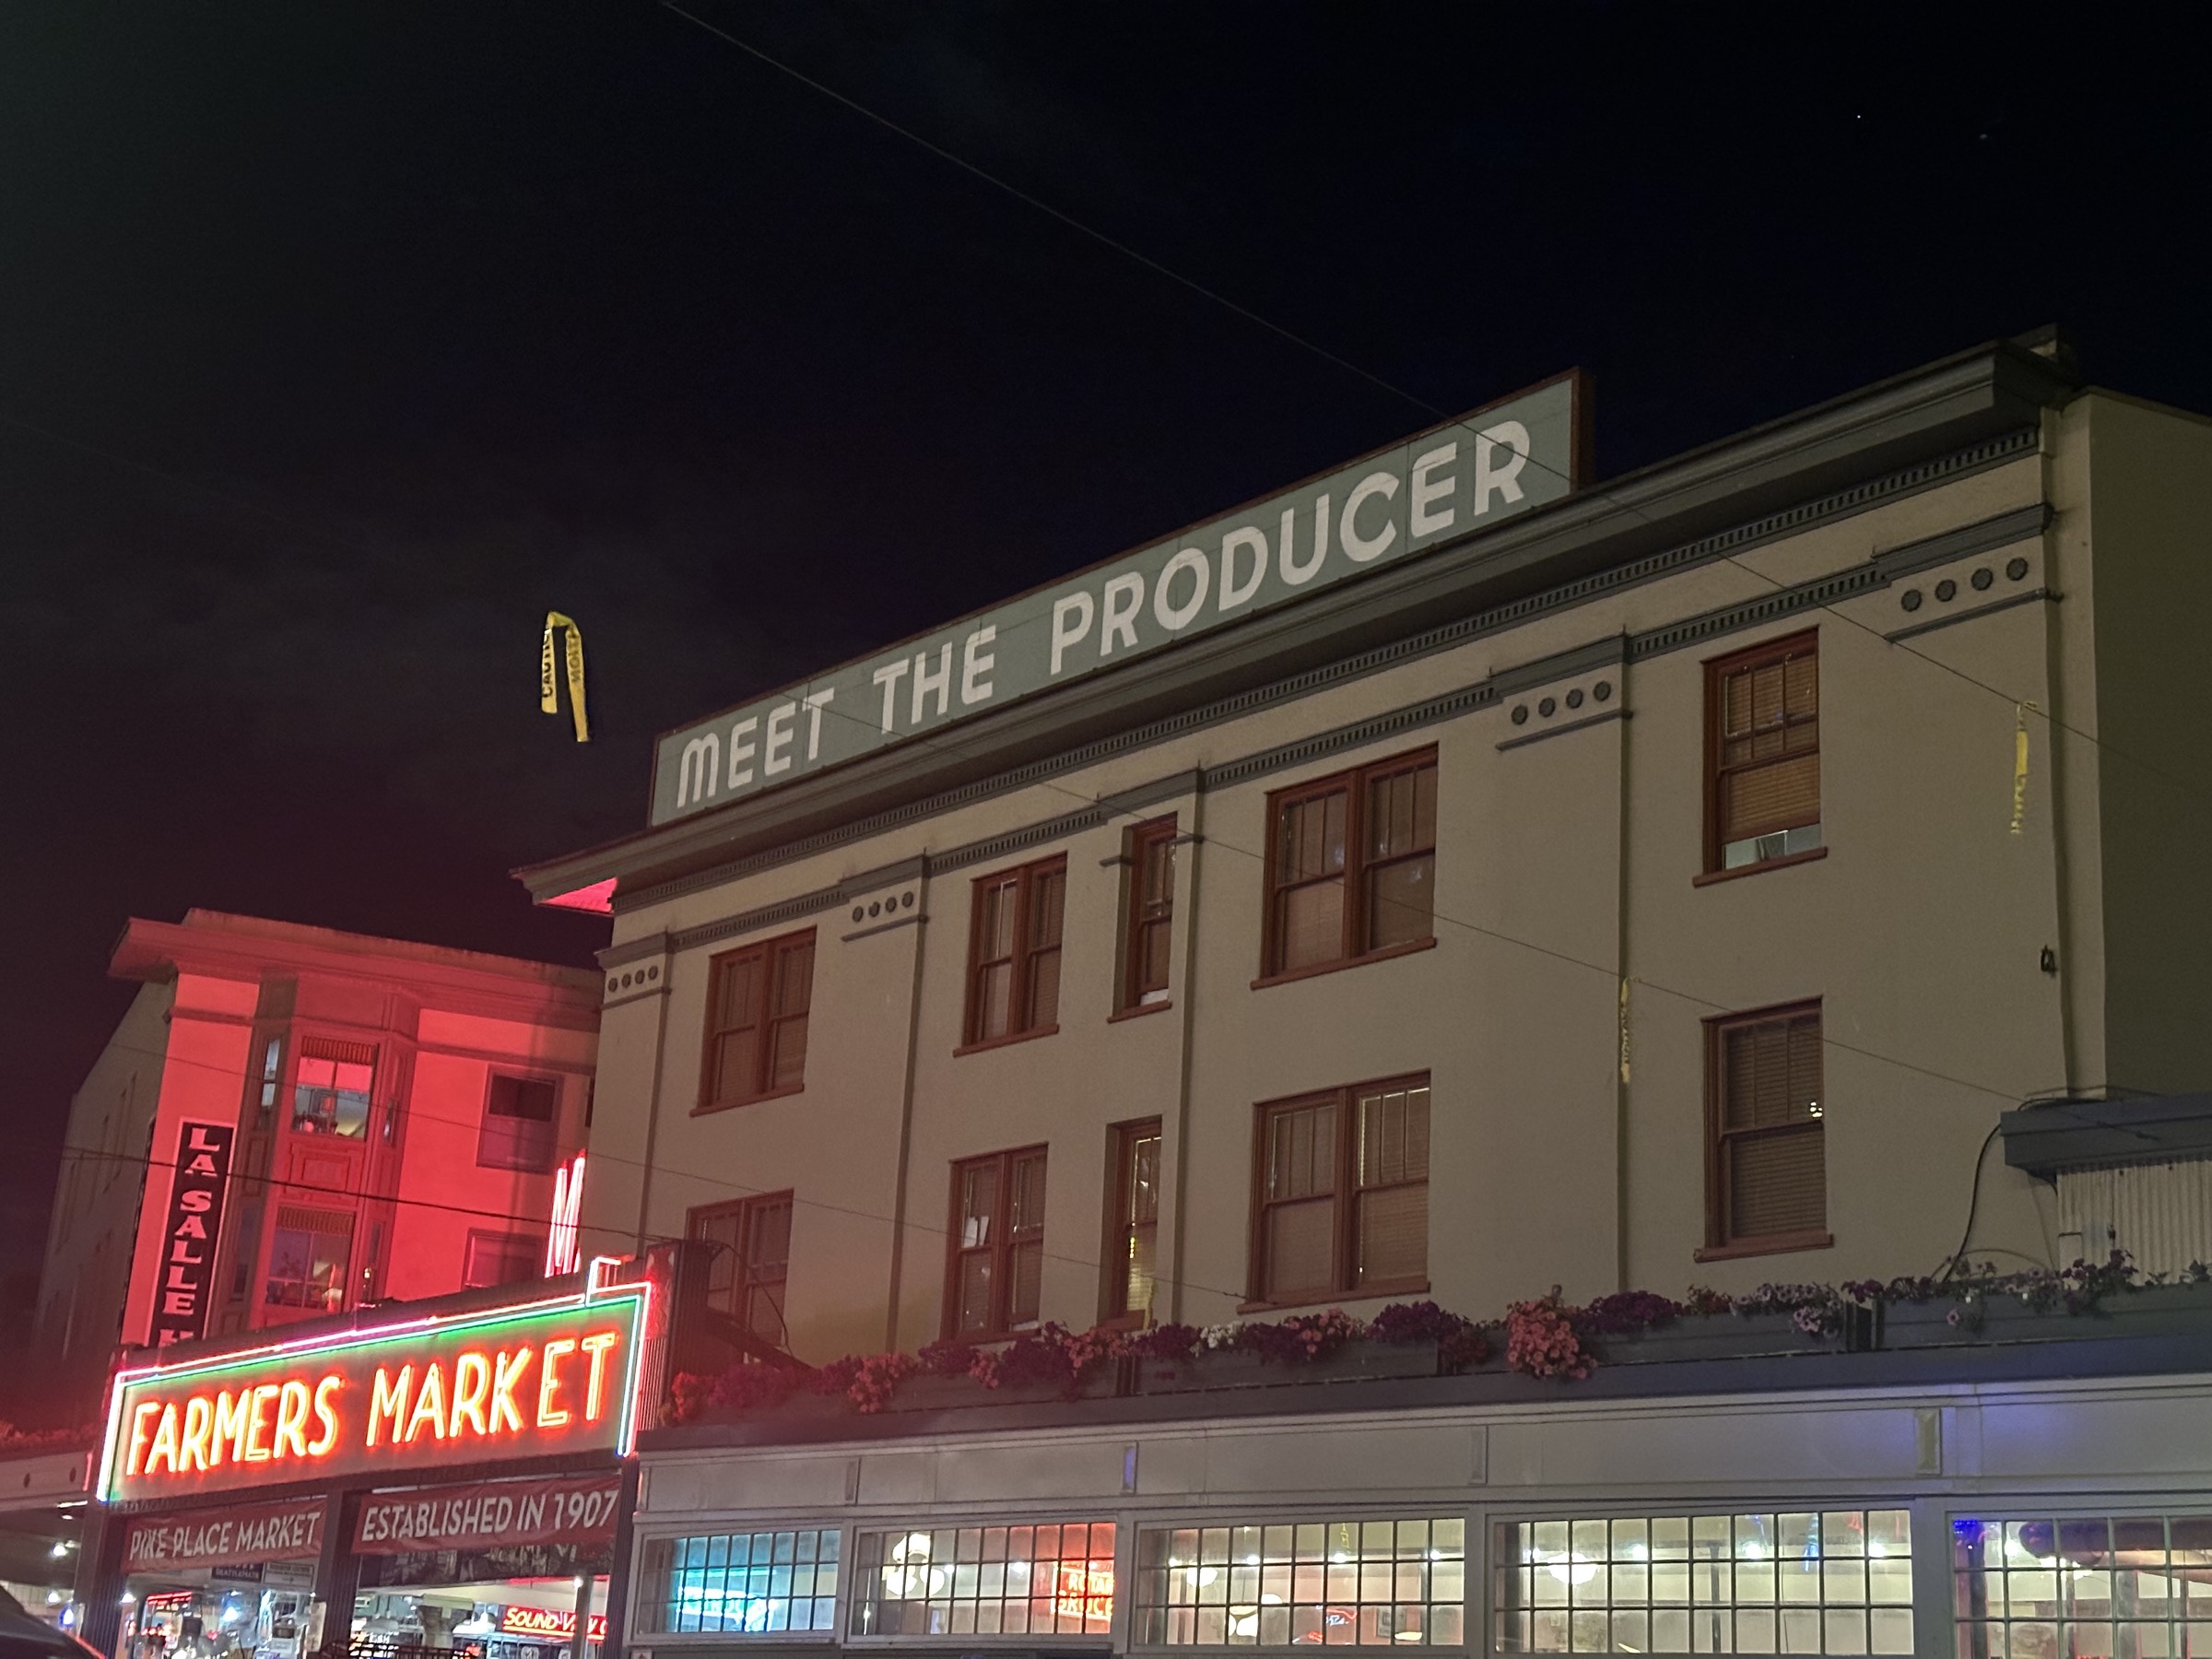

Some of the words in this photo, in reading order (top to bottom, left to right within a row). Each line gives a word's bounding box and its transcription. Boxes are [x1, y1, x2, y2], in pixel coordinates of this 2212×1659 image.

[677, 688, 834, 809] MEET
[872, 625, 996, 735] THE
[1049, 419, 1530, 676] PRODUCER
[184, 1127, 220, 1177] LA
[162, 1189, 212, 1316] SALLE
[125, 1375, 343, 1476] FARMERS
[366, 1332, 617, 1447] MARKET
[130, 1526, 167, 1560] PIKE
[171, 1521, 229, 1559] PLACE
[236, 1511, 321, 1553] MARKET
[361, 1499, 511, 1542] ESTABLISHED
[516, 1493, 546, 1533] IN
[554, 1488, 620, 1530] 1907
[503, 1607, 559, 1630] SOUND
